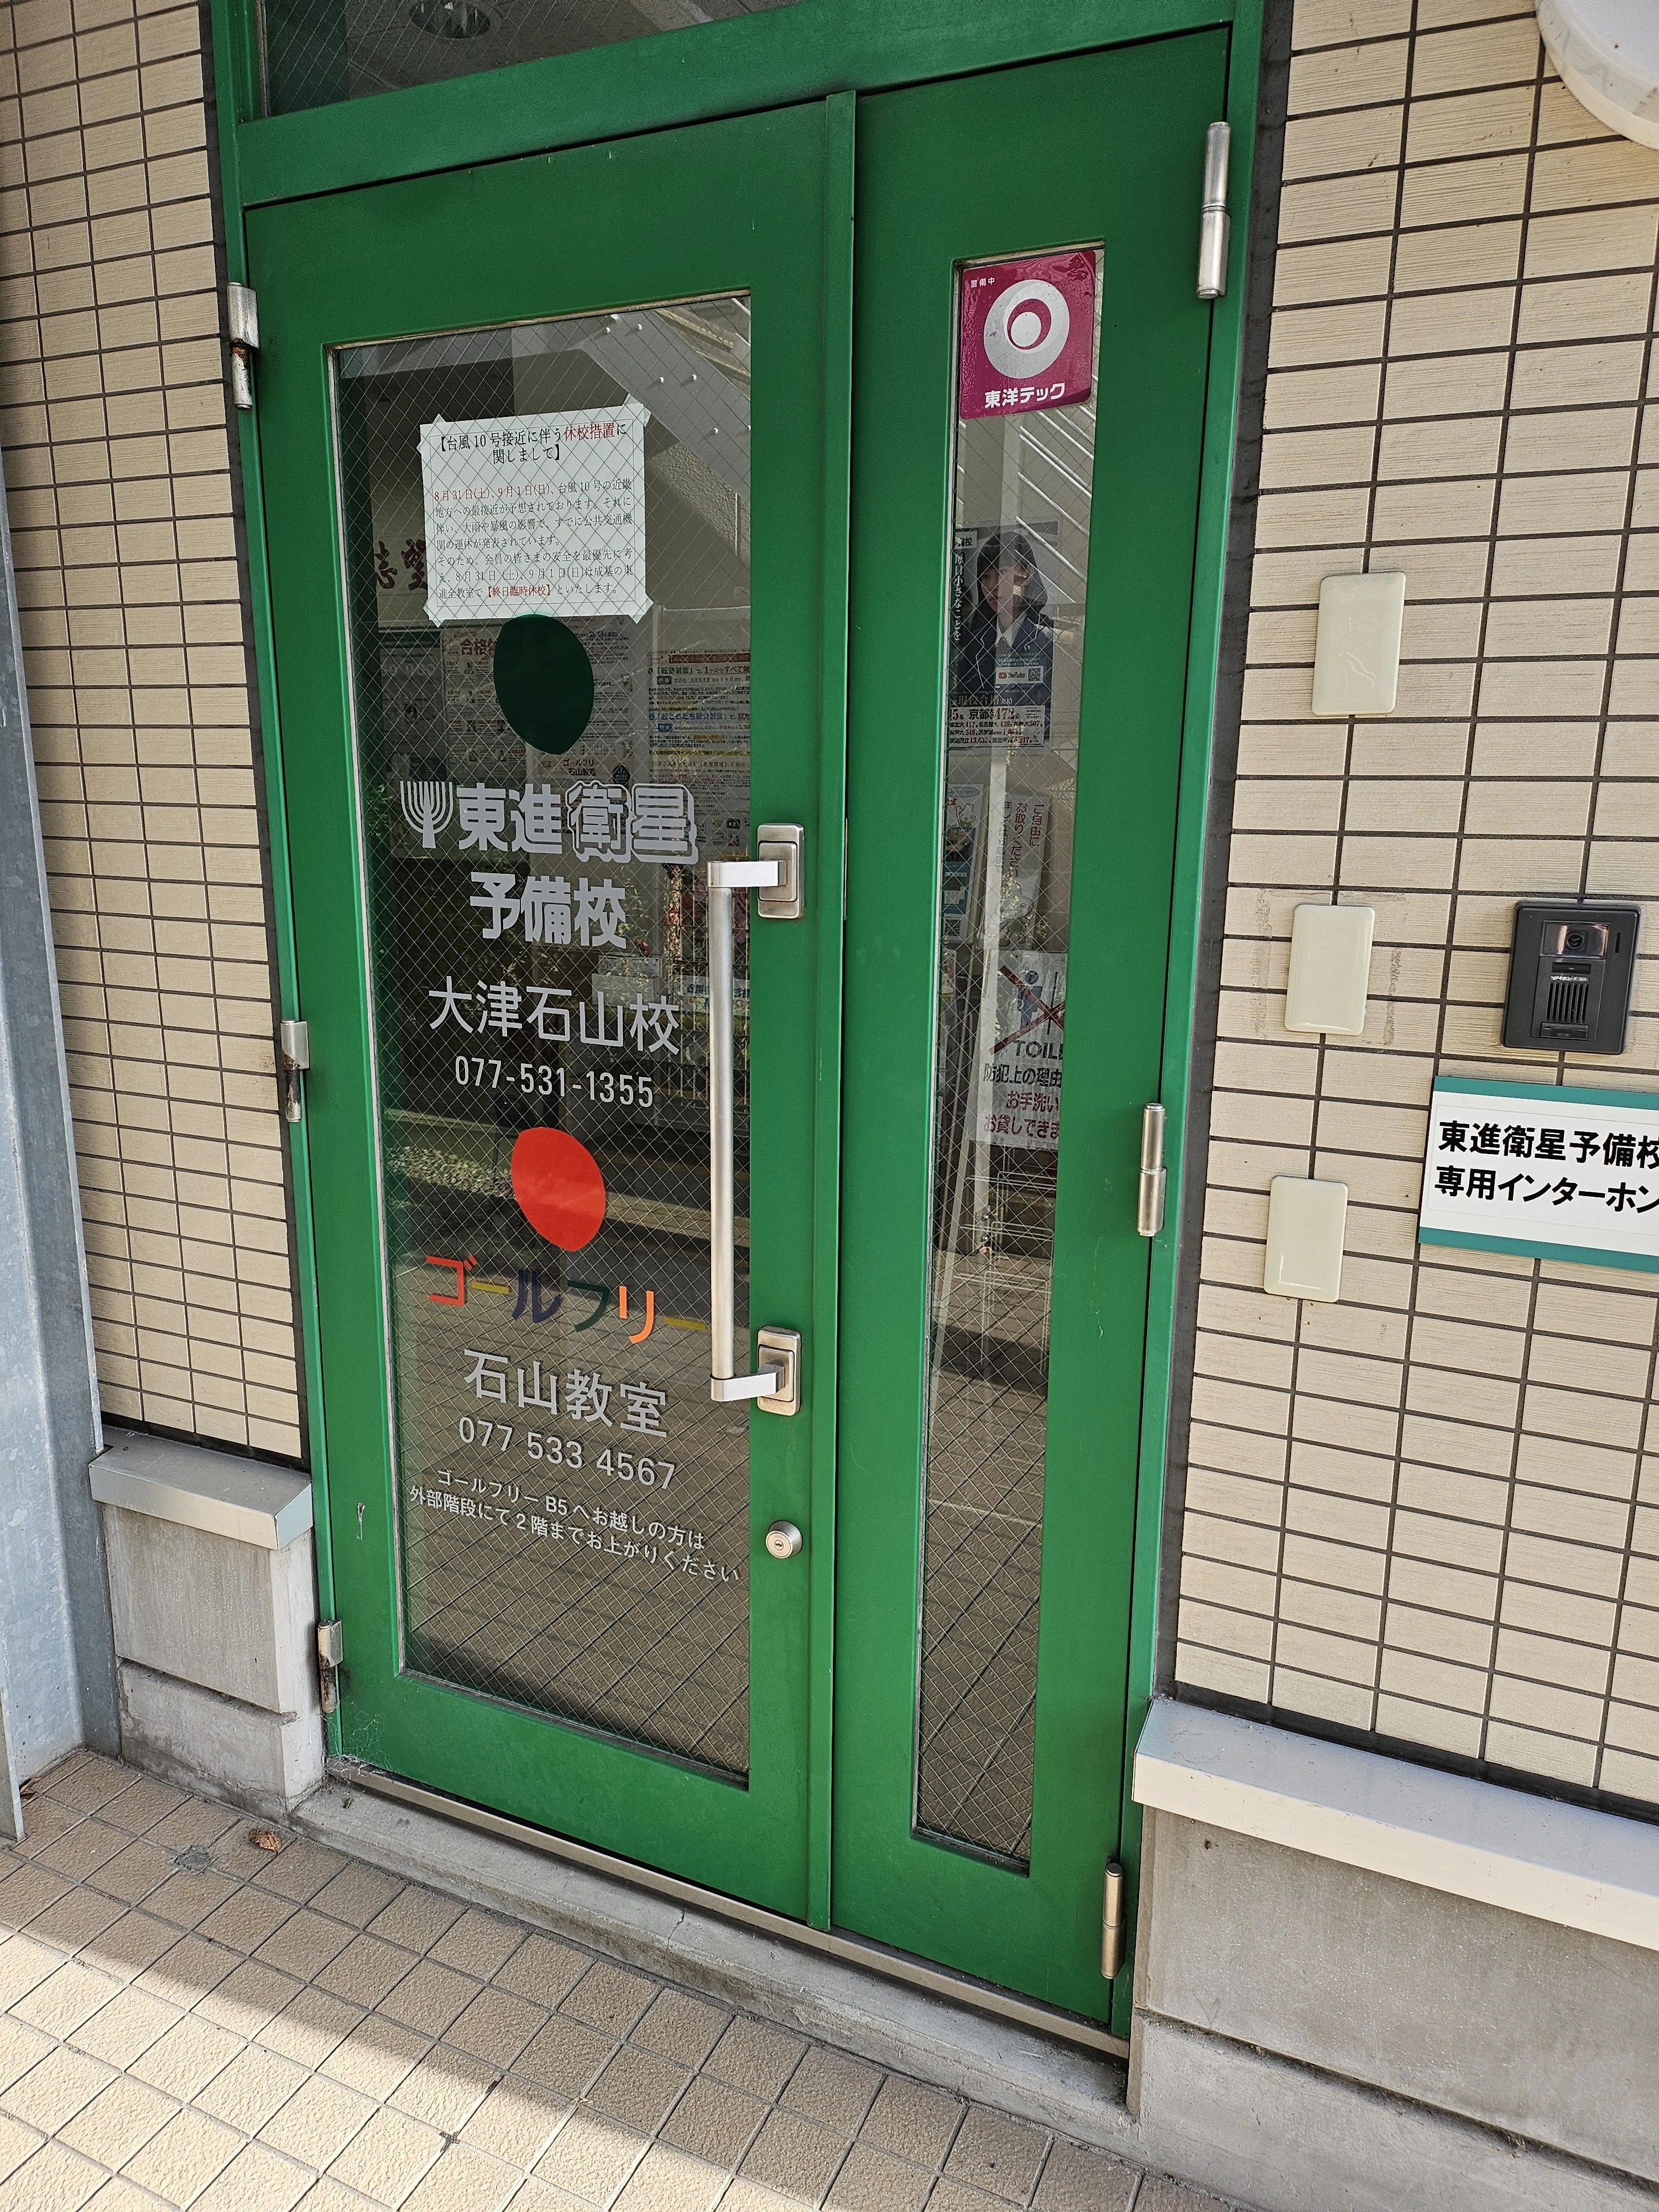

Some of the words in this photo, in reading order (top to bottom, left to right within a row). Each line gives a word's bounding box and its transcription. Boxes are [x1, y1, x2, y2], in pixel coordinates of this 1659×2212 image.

[971, 277, 995, 288] 警備中
[984, 383, 1065, 409] 東洋テック
[493, 445, 560, 465] 関しまして】
[437, 534, 560, 551] 関の運休が発表されています。
[438, 547, 633, 567] そのため、会員の皆さまの安全を最優先に考
[457, 780, 698, 863] 東進衛星
[1029, 803, 1045, 847] ご自由に
[471, 872, 627, 949] 予備校
[429, 975, 680, 1055] 大津石山校
[455, 1055, 654, 1108] 077-531-1355
[1006, 1090, 1060, 1113] お手洗い
[1438, 1119, 1659, 1169] 東進衛星予備校
[1434, 1164, 1659, 1213] 専用インターホン
[426, 1255, 706, 1344] ゴールフリー
[463, 1348, 668, 1438] 石山教室
[459, 1417, 513, 1452] 077
[527, 1433, 583, 1469] 533
[596, 1448, 676, 1489] 4567
[409, 1487, 740, 1583] 外部階段にて2階までお上がりください
